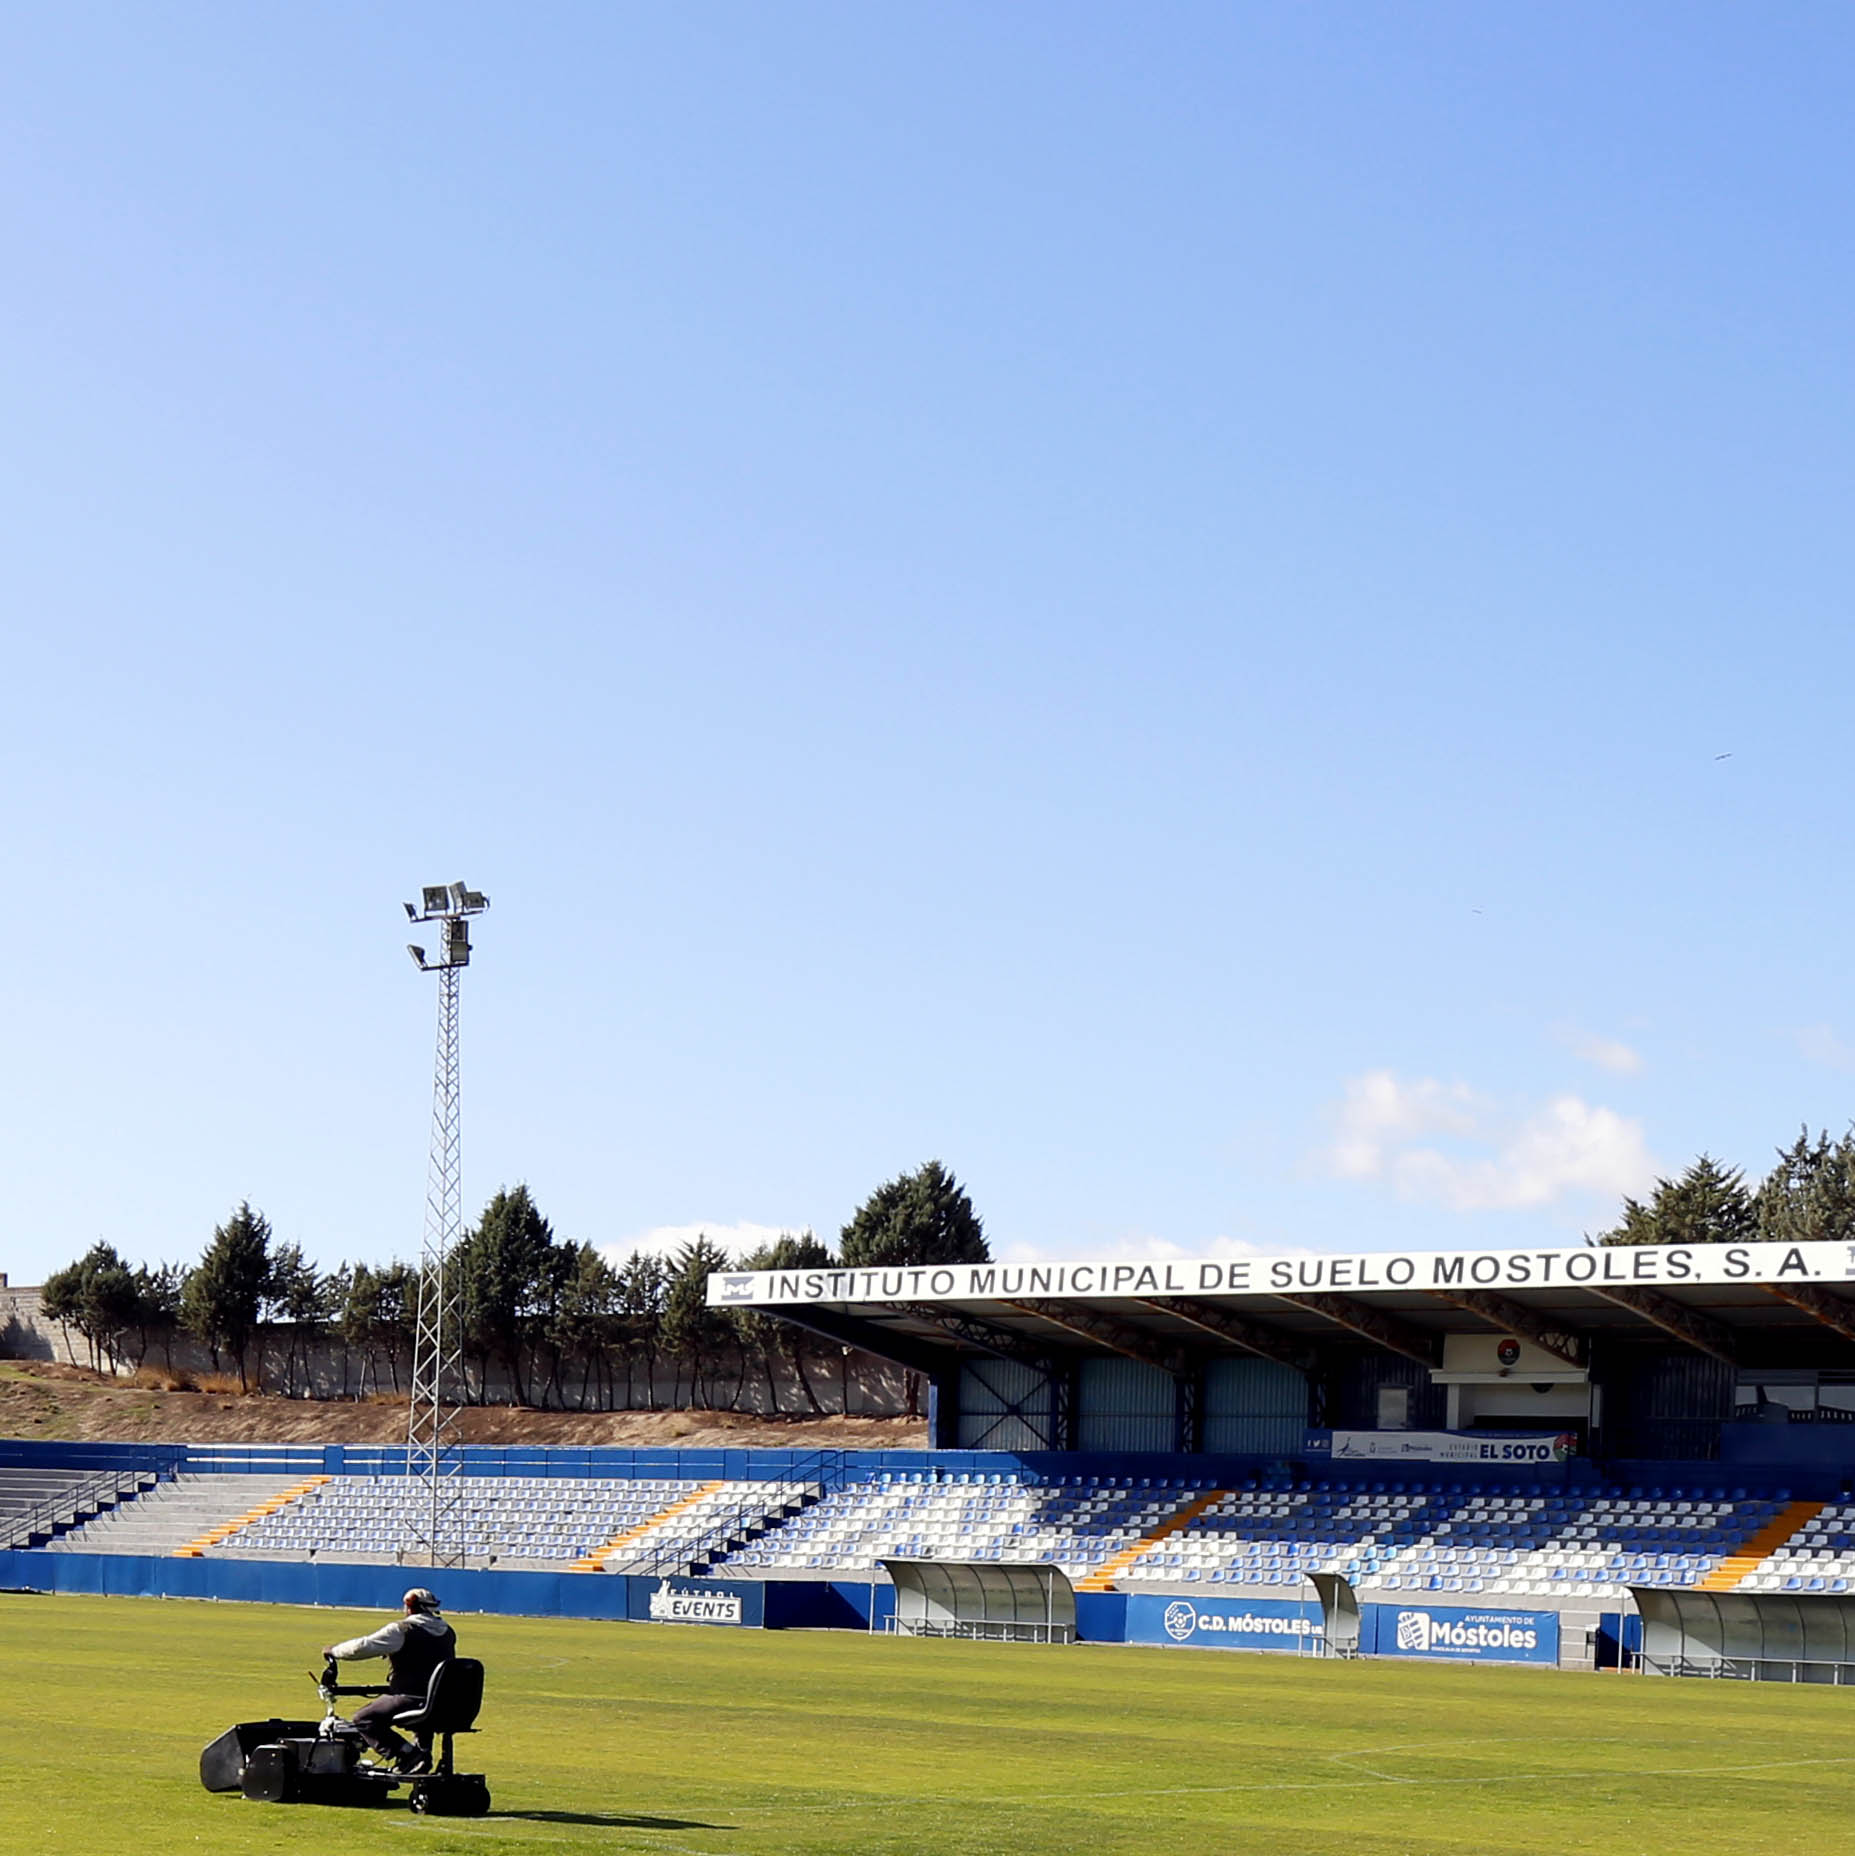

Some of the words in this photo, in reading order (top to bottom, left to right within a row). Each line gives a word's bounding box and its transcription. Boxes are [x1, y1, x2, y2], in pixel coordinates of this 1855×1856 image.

[768, 1270, 955, 1299] INSTITUTO
[969, 1265, 1185, 1294] MUNICIPAL
[1199, 1262, 1251, 1289] DE
[1270, 1257, 1415, 1288] SUELO
[1433, 1250, 1701, 1283] MOSTOLES,
[1723, 1249, 1761, 1278] S.
[1777, 1247, 1821, 1277] A.
[1479, 1444, 1498, 1459] EL
[1502, 1444, 1550, 1460] SOTO
[670, 1586, 735, 1598] FÚTBOL
[672, 1600, 736, 1618] EVENTS
[1198, 1615, 1227, 1631] C.D.
[1228, 1613, 1311, 1635] MÓSTOLES
[1465, 1615, 1523, 1625] AYUNTAMIENTO
[1524, 1616, 1535, 1625] DE
[1431, 1621, 1537, 1648] Móstoles
